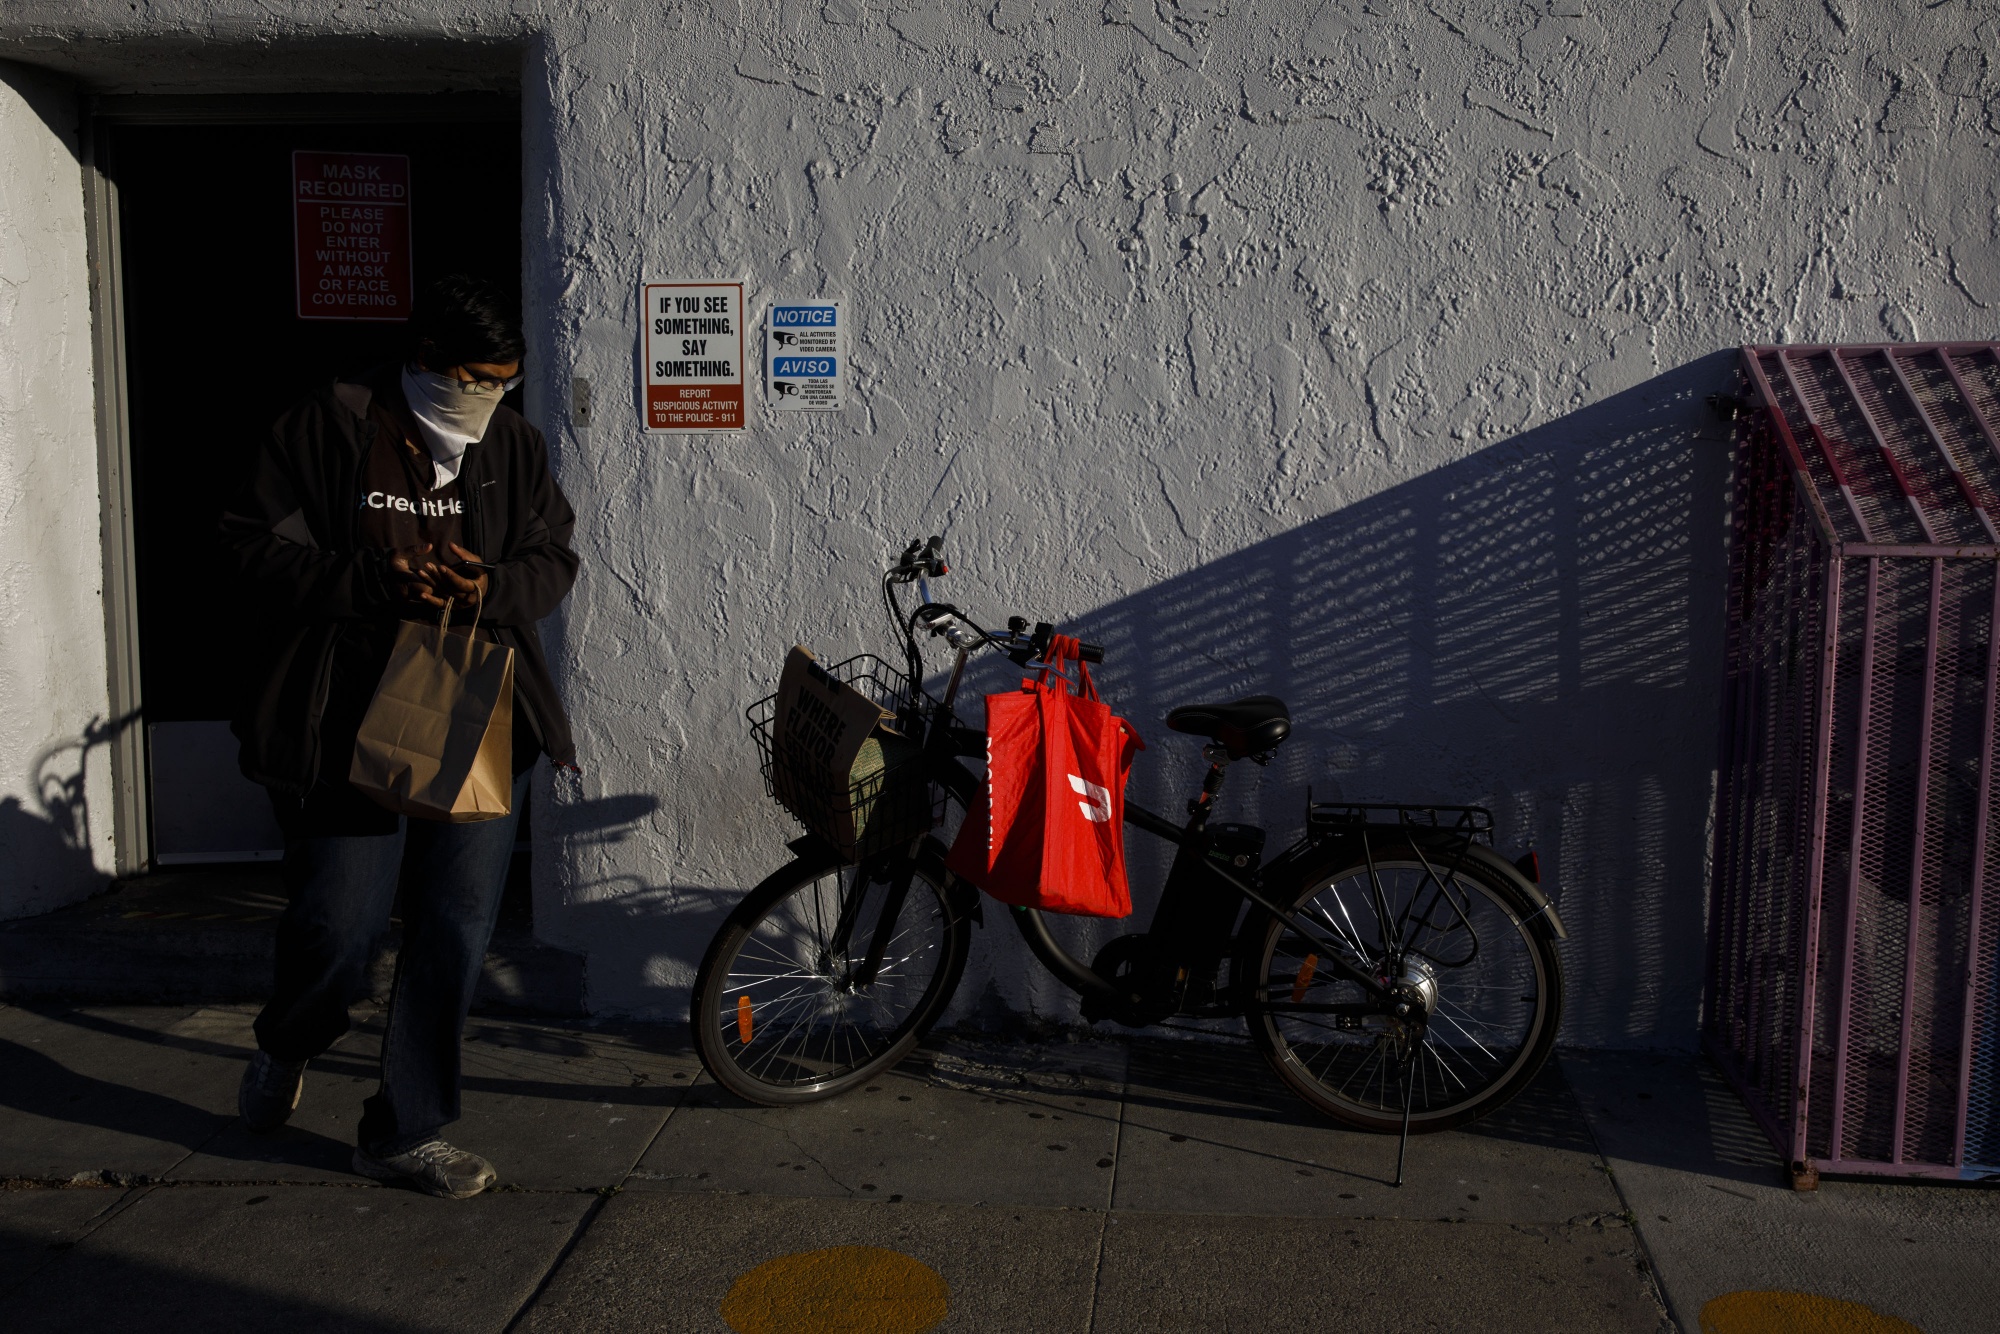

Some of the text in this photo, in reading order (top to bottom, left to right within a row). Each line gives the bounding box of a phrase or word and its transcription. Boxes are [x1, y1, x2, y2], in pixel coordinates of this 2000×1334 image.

[323, 164, 381, 180] MASK
[299, 180, 405, 198] REQUIRED
[320, 206, 384, 220] PLEASE
[322, 221, 384, 235] DO NOT
[326, 235, 380, 249] ENTER
[316, 250, 391, 263] WITHOUT
[323, 264, 385, 277] A MASK
[319, 278, 389, 292] OR FACE
[312, 293, 397, 306] COVERING
[660, 296, 728, 313] IF YOU SEE
[776, 310, 833, 323] NOTICE
[655, 318, 734, 336] SOMETHING,
[682, 339, 707, 356] SAY
[655, 360, 734, 377] SOMETHING.
[780, 361, 830, 373] AVISO
[679, 389, 711, 398] REPORT
[653, 400, 738, 411] SUSPICIOUS ACTIVITY
[655, 413, 667, 422] TO
[668, 413, 683, 422] THE
[685, 413, 714, 422] POLICE
[721, 413, 736, 422] 911
[797, 685, 846, 746] WHERE
[786, 706, 836, 770] FLAVOR
